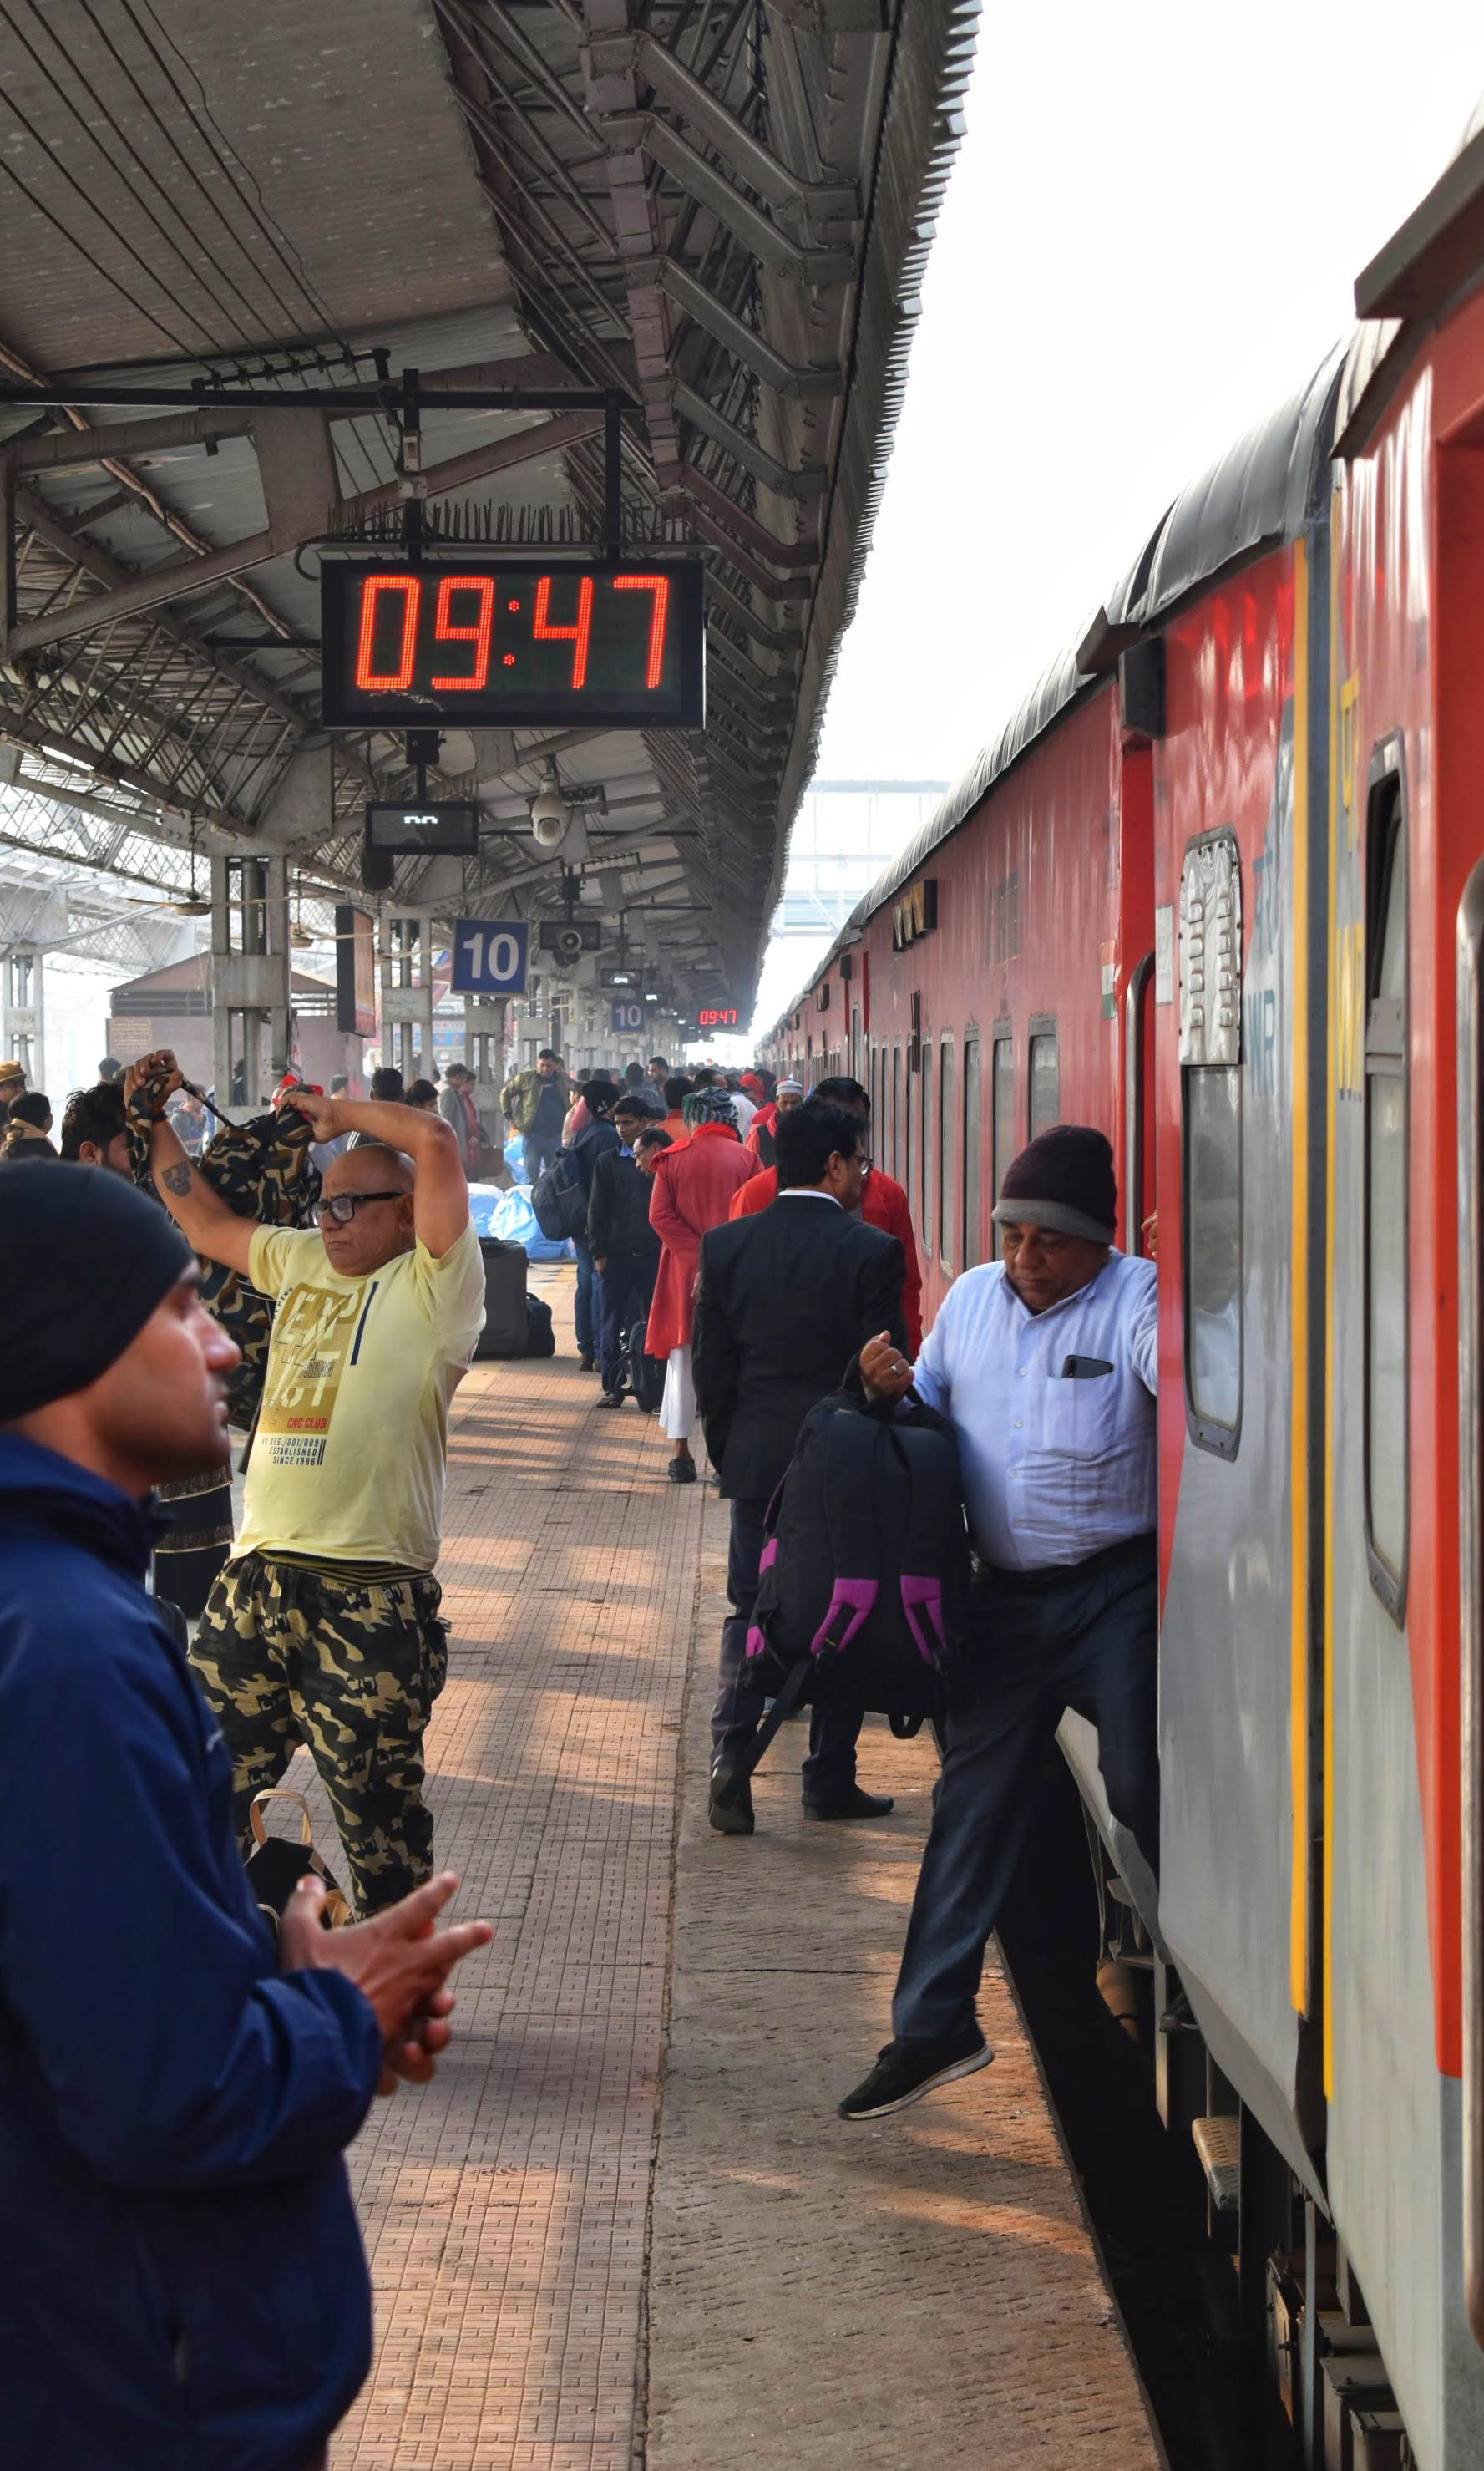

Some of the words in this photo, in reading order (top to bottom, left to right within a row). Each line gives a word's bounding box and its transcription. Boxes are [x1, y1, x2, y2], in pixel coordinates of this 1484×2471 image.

[357, 576, 668, 689] 09:47
[463, 932, 519, 982] 10
[615, 1005, 642, 1027] 10
[699, 1009, 738, 1026] 09:47
[286, 1418, 304, 1428] CNC
[305, 1418, 327, 1429] CLUB
[269, 1447, 317, 1456] ESTABLISHED
[273, 1456, 294, 1464] SINCE
[296, 1457, 316, 1465] 1996
